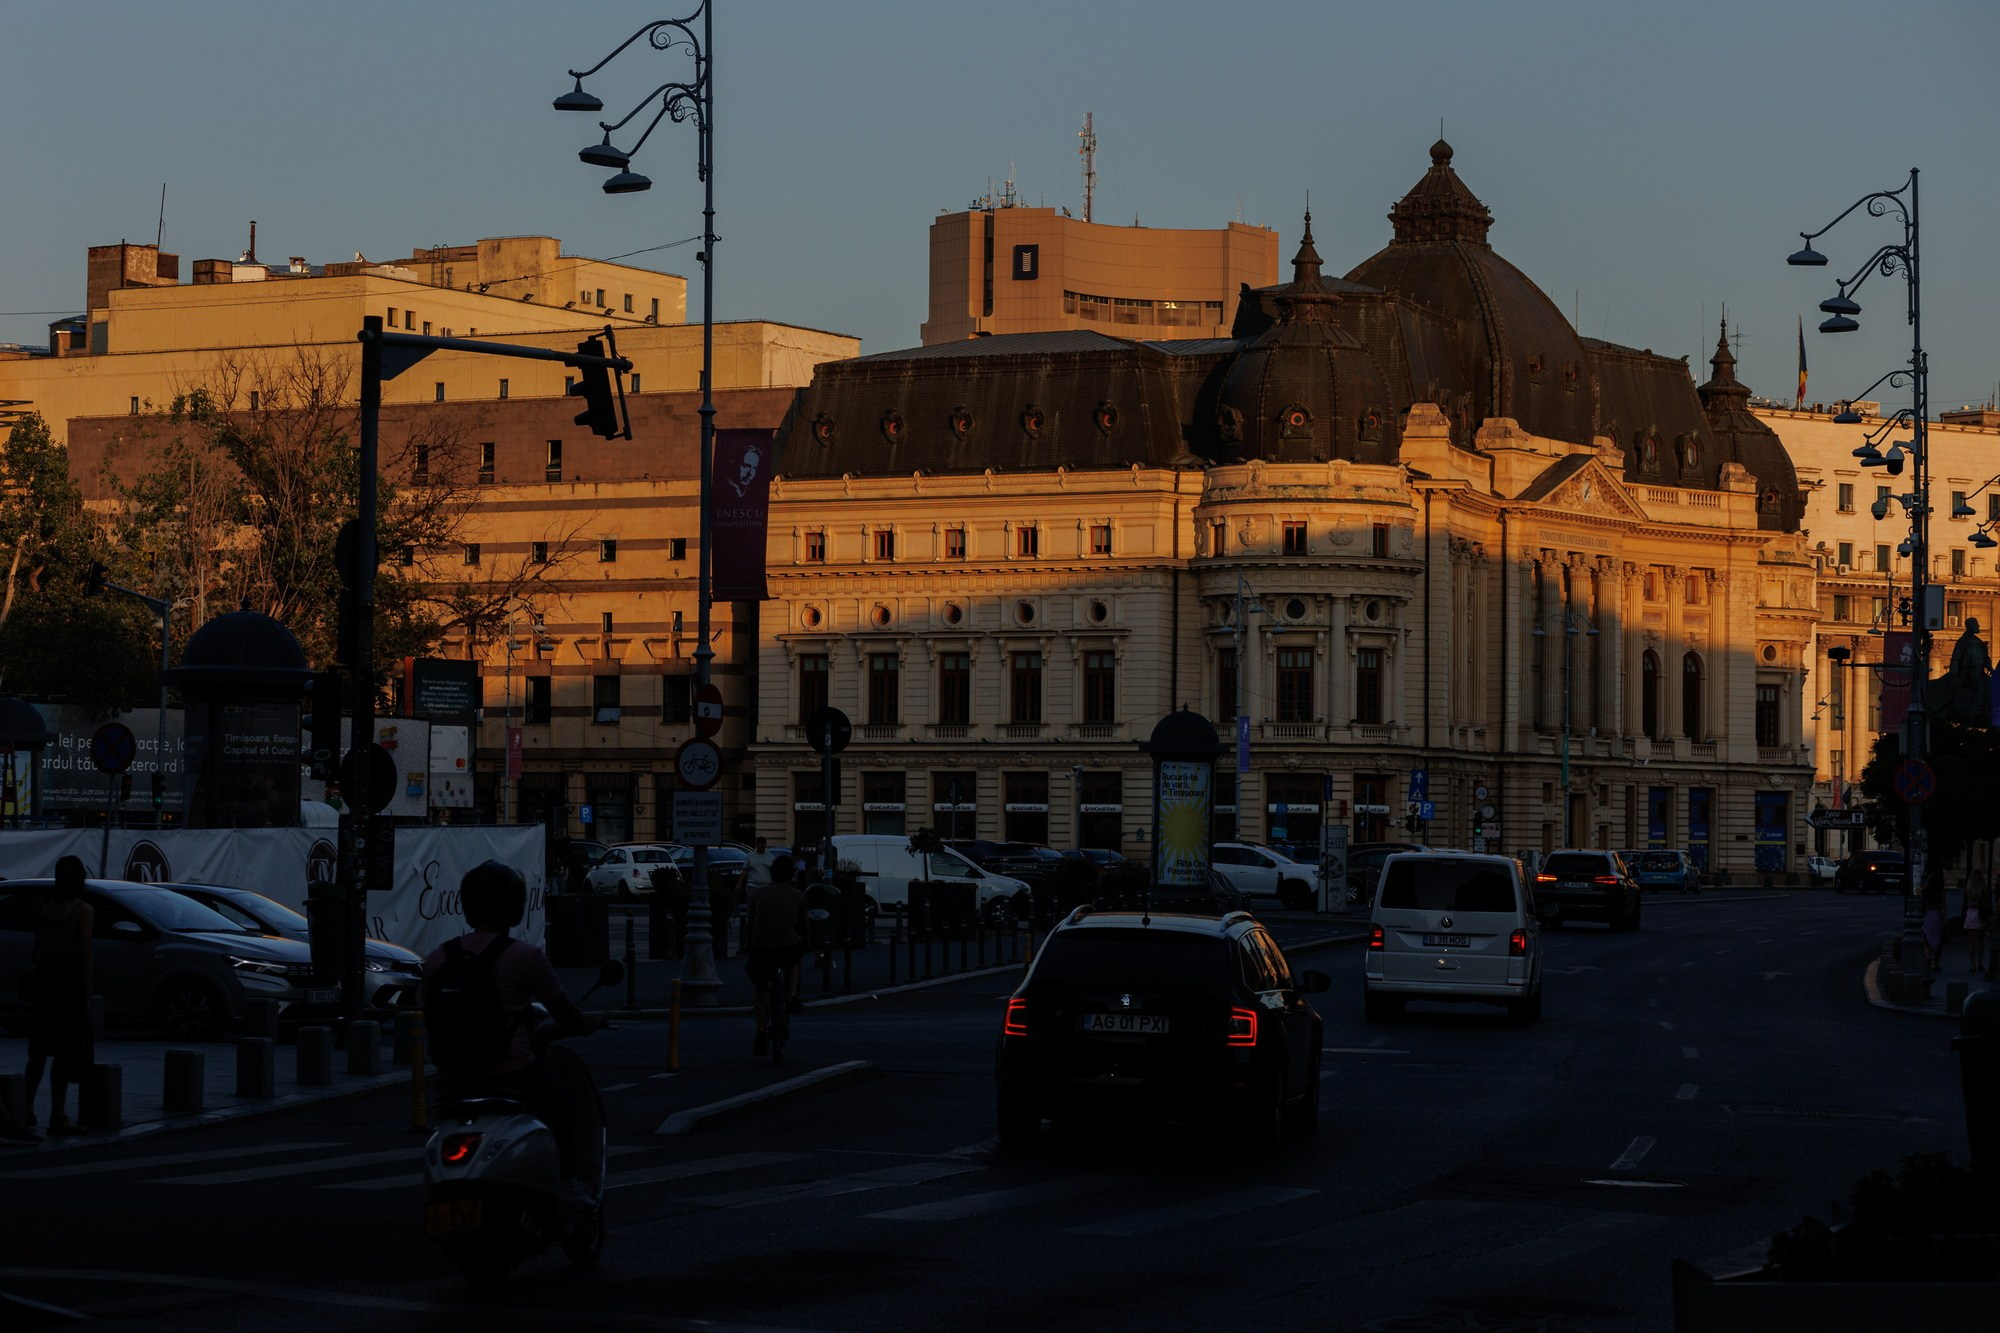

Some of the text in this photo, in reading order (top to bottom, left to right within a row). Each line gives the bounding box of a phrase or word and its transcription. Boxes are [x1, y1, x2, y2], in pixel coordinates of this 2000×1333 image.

[716, 508, 763, 519] ENESCU
[58, 732, 73, 748] lei
[224, 746, 258, 757] Capital
[259, 746, 270, 755] of
[1176, 859, 1192, 868] Rita
[1092, 1015, 1115, 1030] AG
[1120, 1016, 1134, 1030] 01
